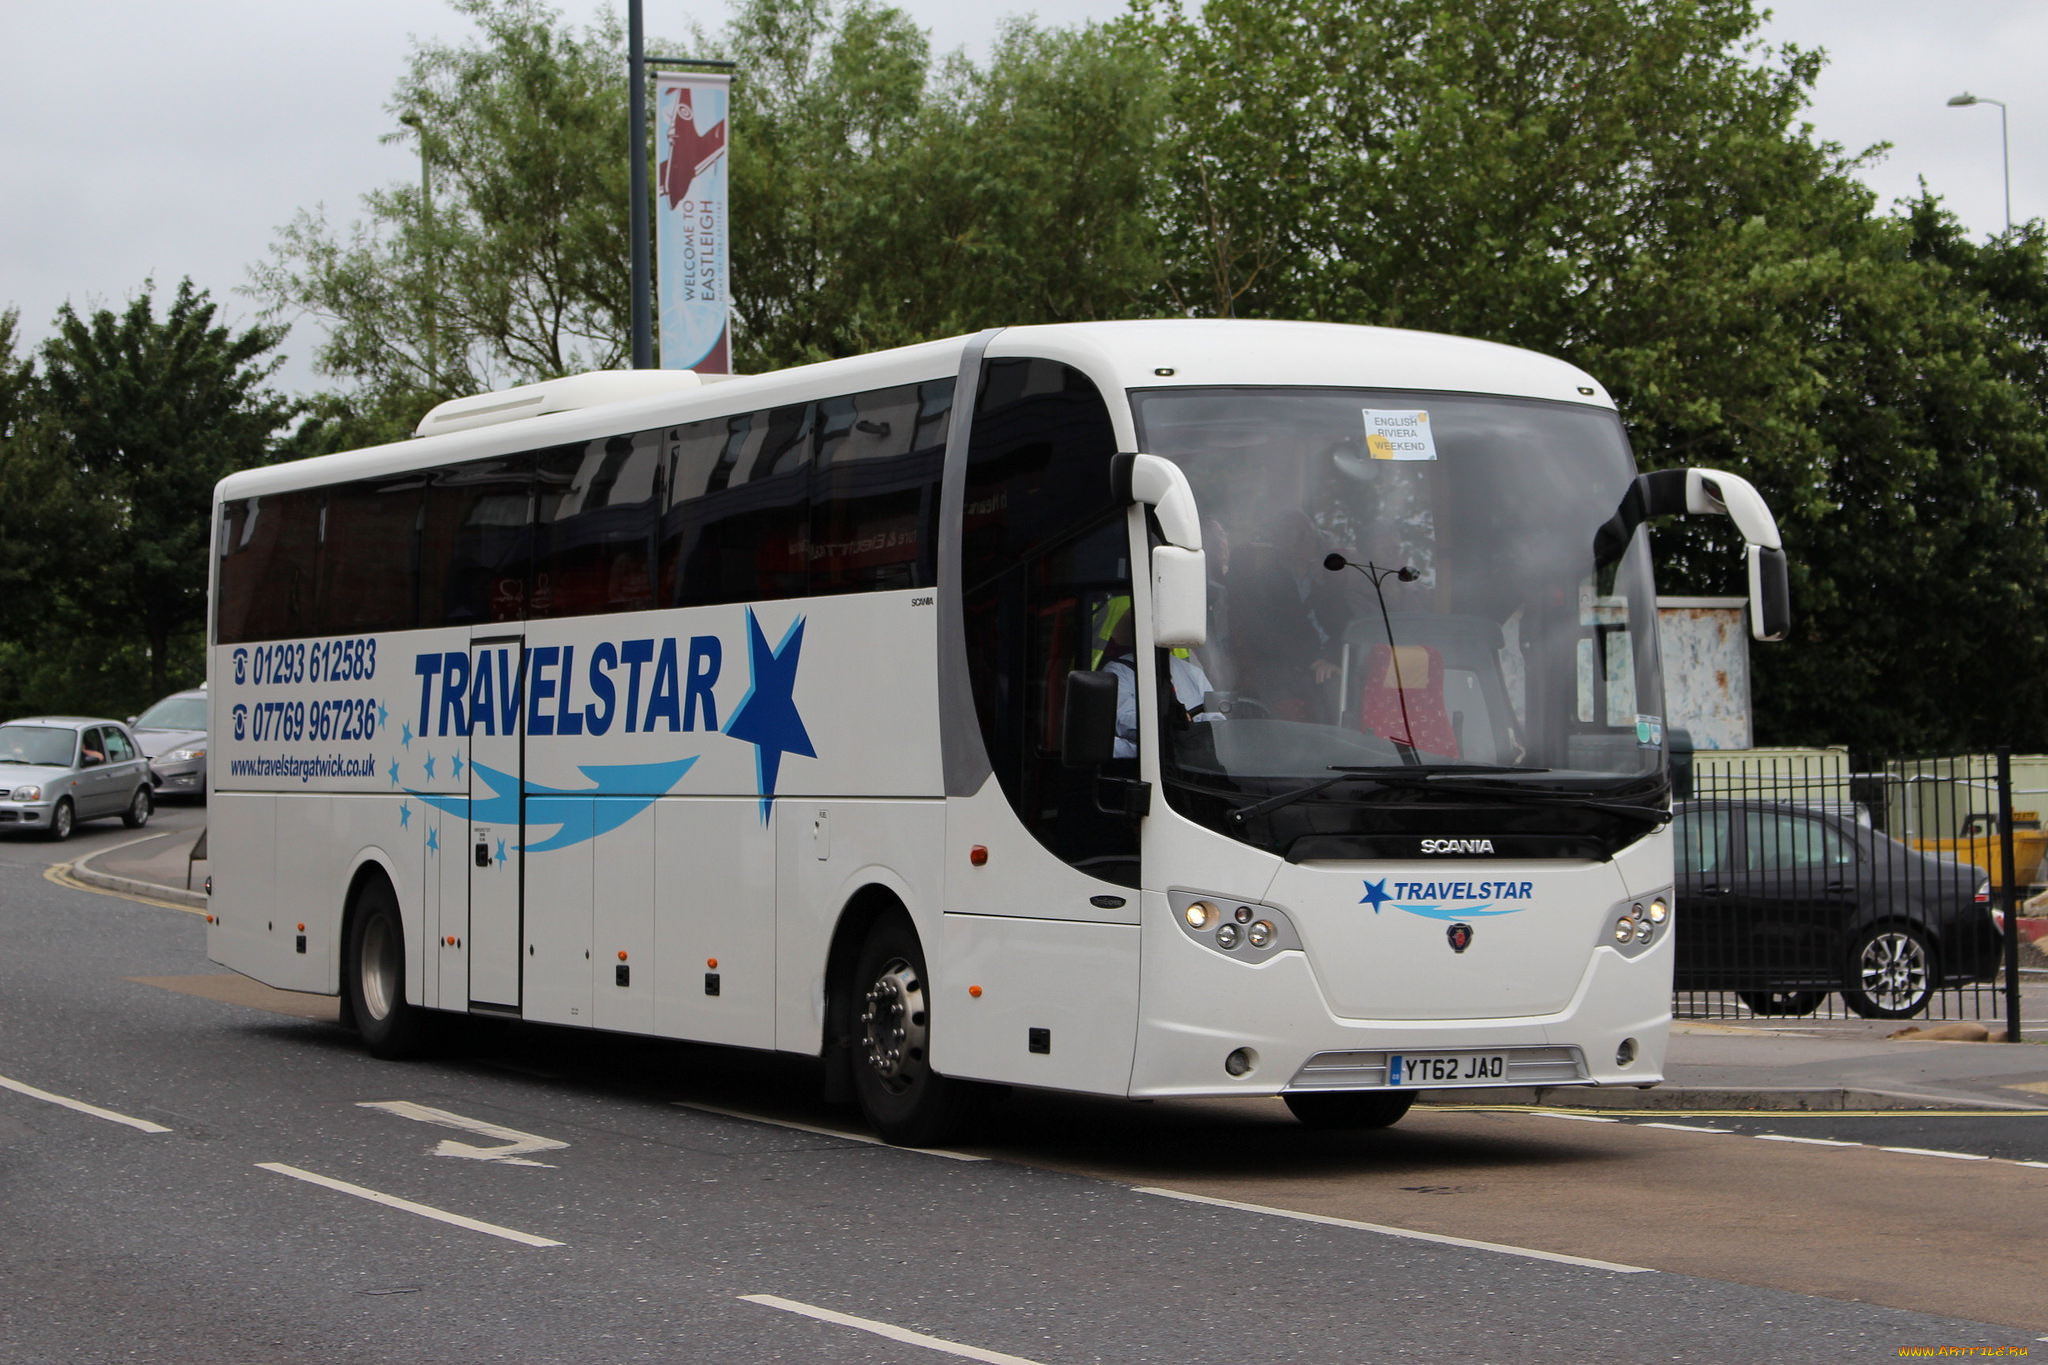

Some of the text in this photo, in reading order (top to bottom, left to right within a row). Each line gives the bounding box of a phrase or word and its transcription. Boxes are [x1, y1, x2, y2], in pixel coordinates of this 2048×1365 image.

[683, 200, 696, 301] WELCOME TO
[700, 200, 716, 301] EASTLEIGH
[1374, 417, 1418, 427] ENGLISH
[1377, 428, 1418, 438] RIVIERA
[1374, 441, 1426, 451] WEEKEND
[253, 638, 377, 685] 01293 612583
[415, 635, 722, 738] TRAVELSTAR
[252, 698, 376, 742] 07769 967236
[231, 753, 376, 783] www.travelstargatwick.co.uk
[1420, 839, 1495, 854] SCANIA
[1394, 881, 1533, 901] TRAVELSTAR
[1405, 1056, 1503, 1081] YT62 JAO
